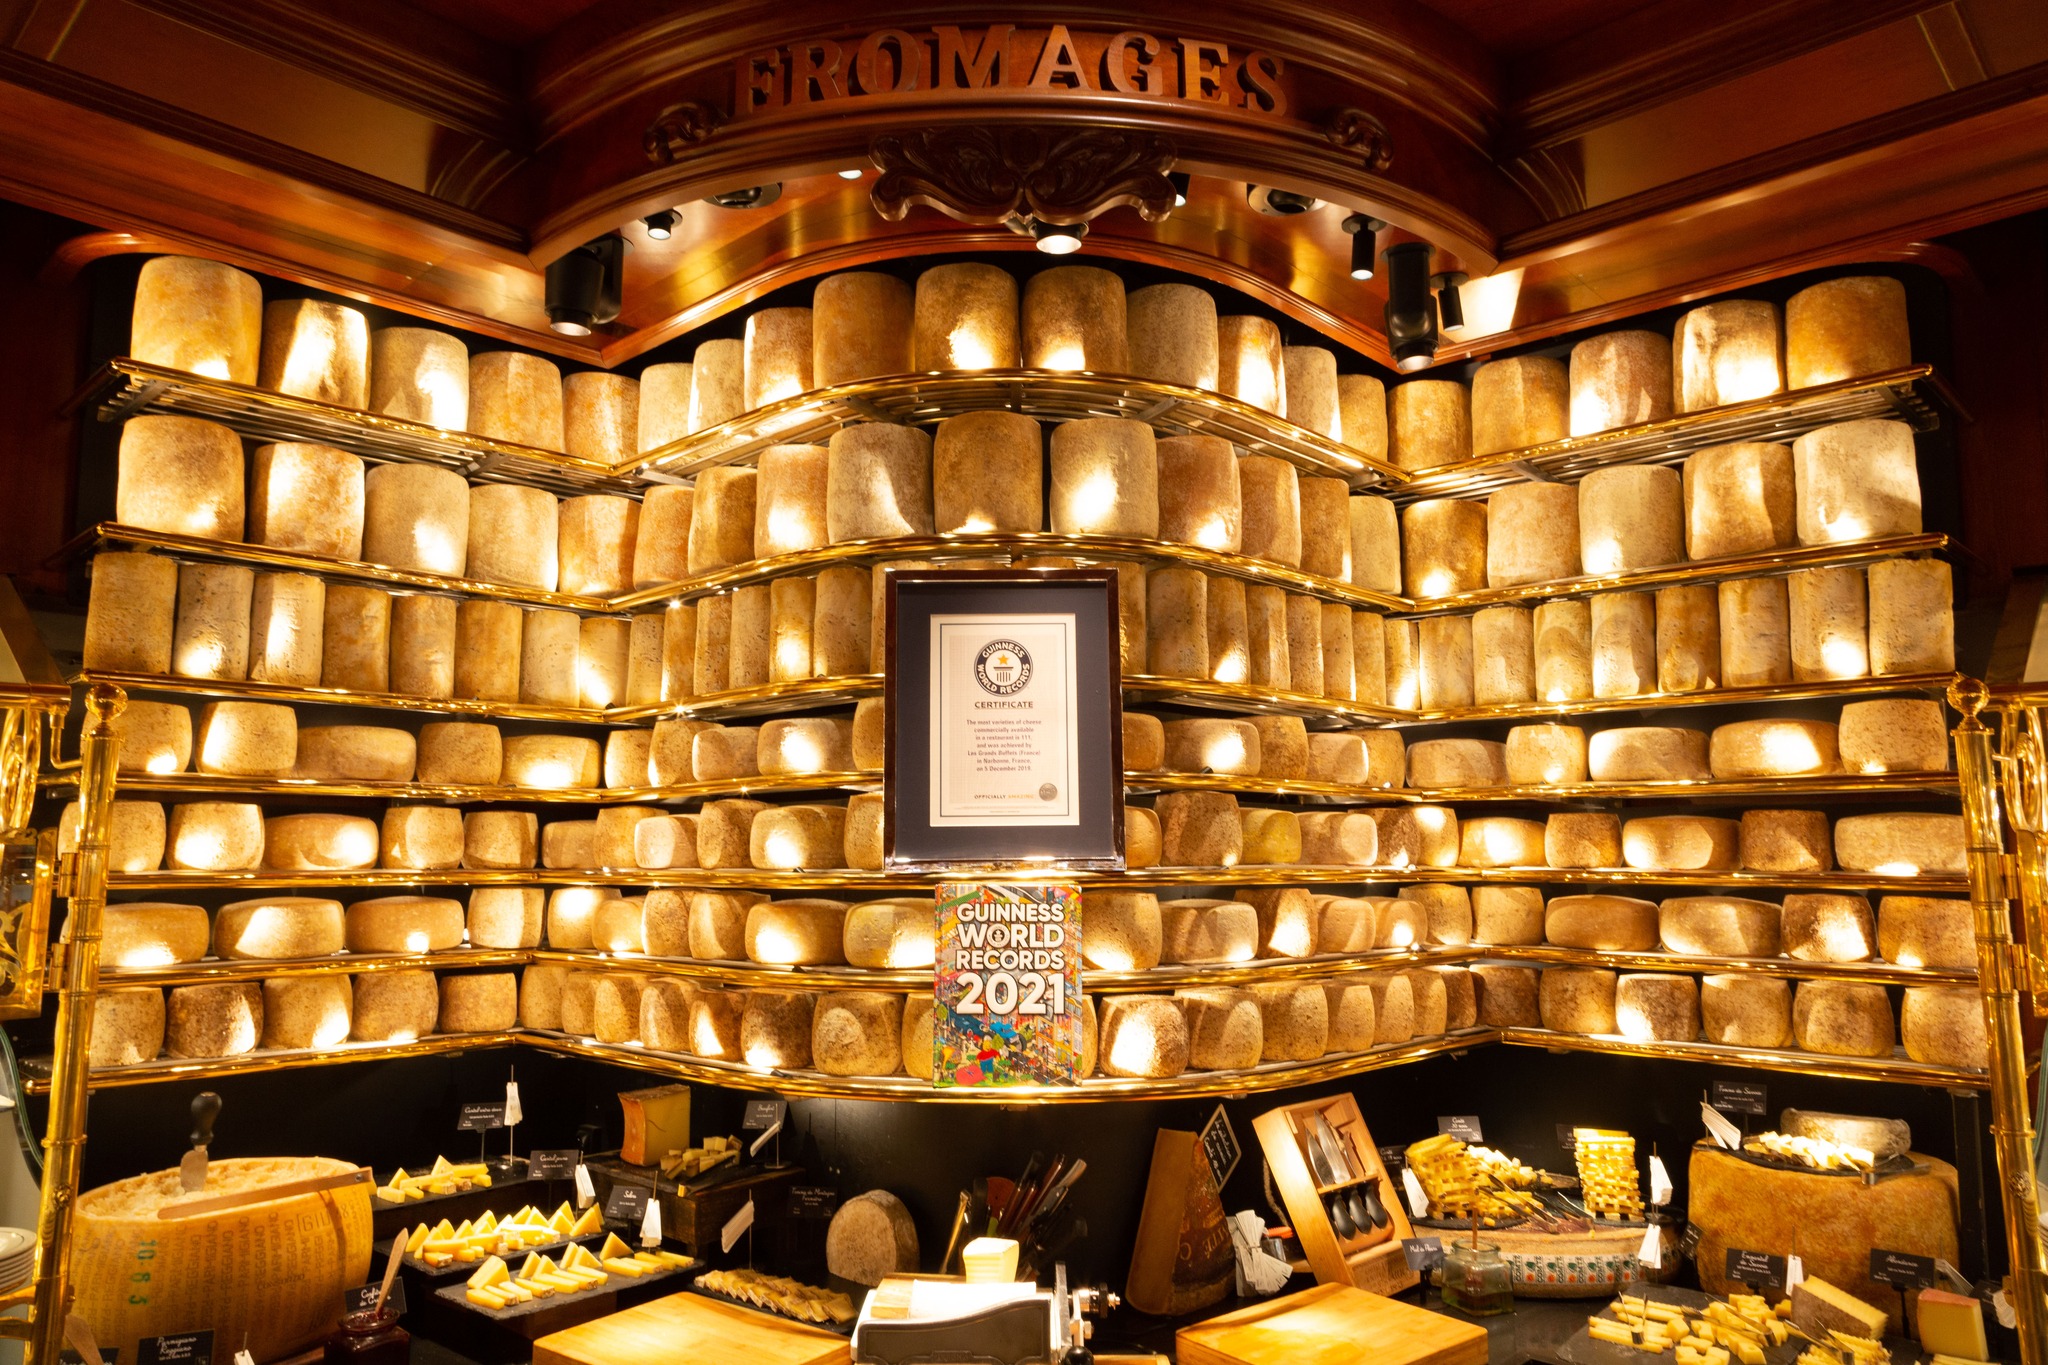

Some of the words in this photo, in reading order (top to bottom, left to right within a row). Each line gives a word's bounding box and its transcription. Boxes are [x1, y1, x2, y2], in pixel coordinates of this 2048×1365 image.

[735, 24, 1287, 116] FROMAGES
[982, 642, 1025, 658] GUINNESS
[977, 664, 998, 692] WORLD
[1000, 663, 1030, 694] RECORDS
[974, 701, 1033, 709] CERTIFICATE
[957, 903, 1065, 922] GUINNESS
[957, 923, 1065, 948] WORLD
[956, 950, 1065, 970] RECORDS
[956, 972, 1065, 1015] 2021
